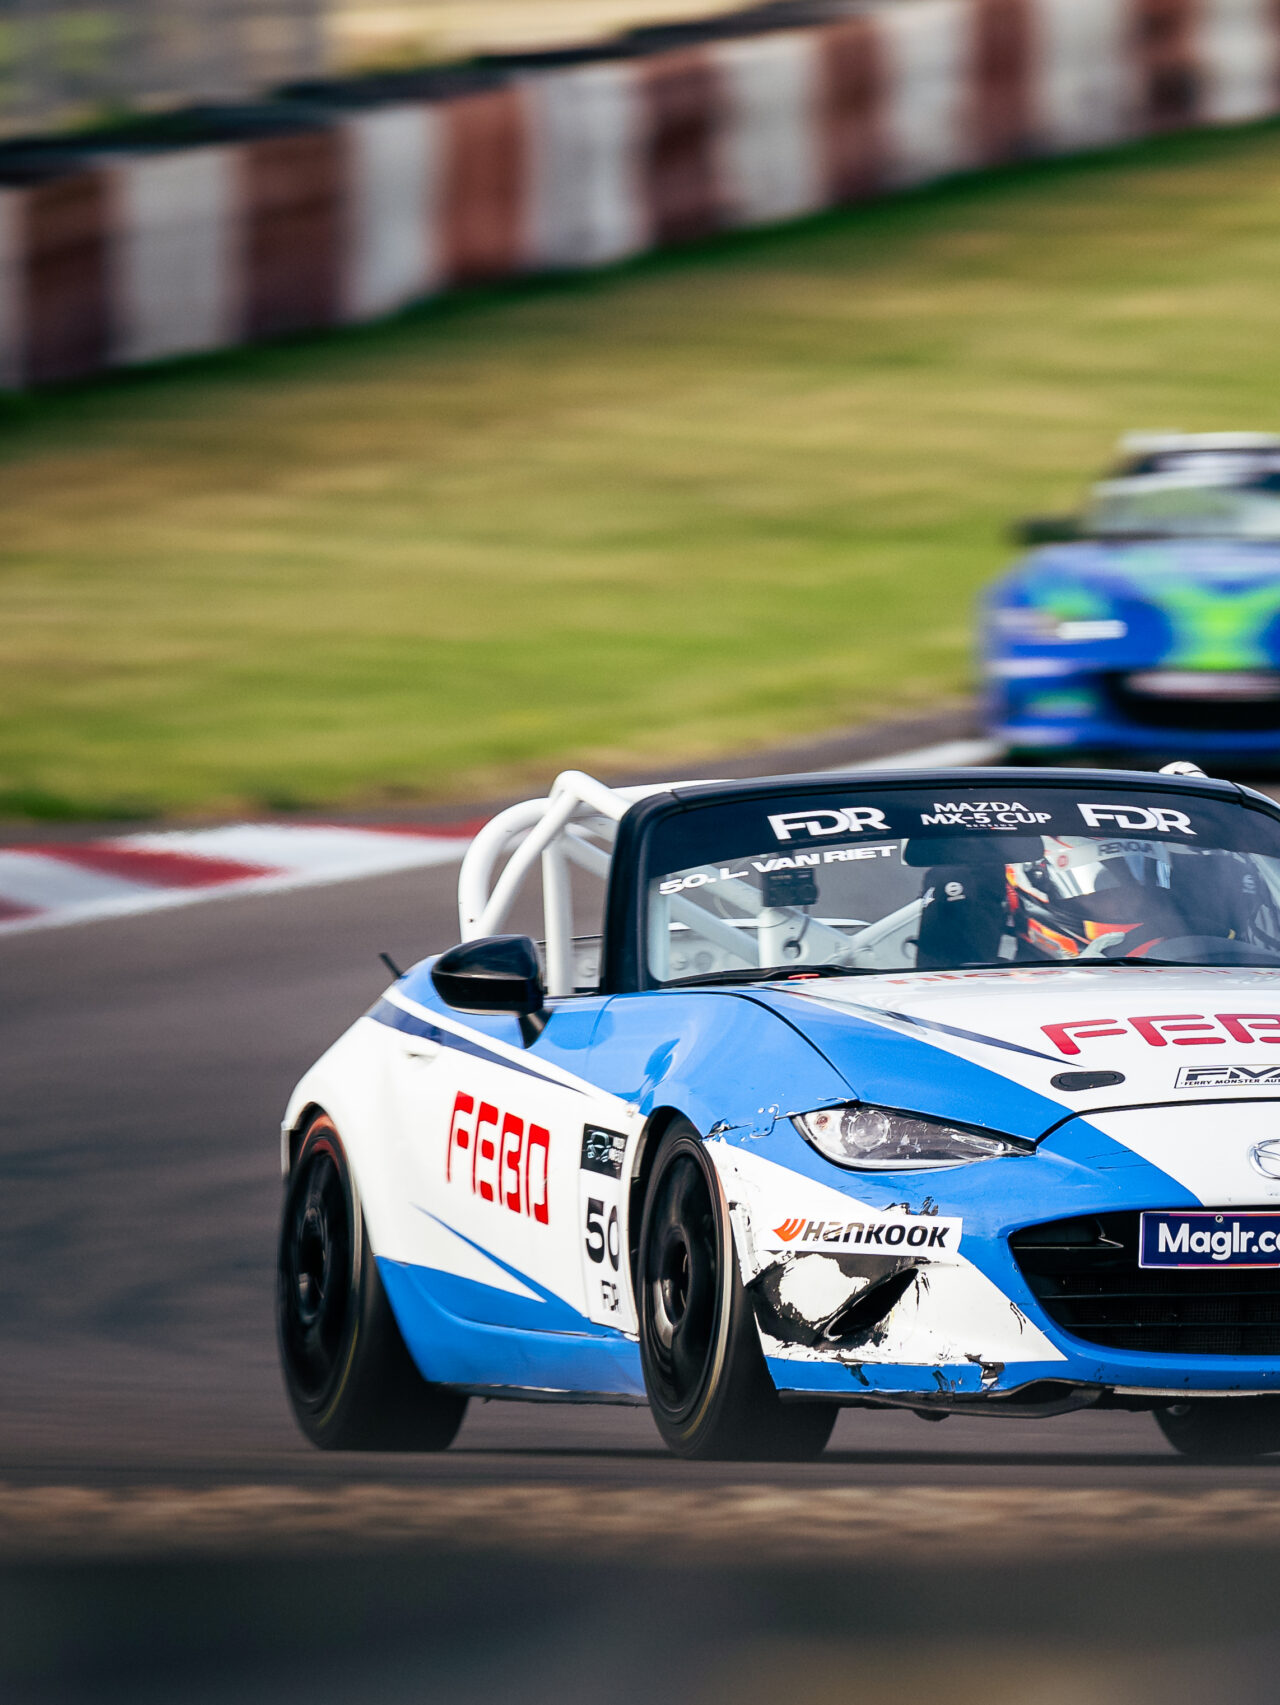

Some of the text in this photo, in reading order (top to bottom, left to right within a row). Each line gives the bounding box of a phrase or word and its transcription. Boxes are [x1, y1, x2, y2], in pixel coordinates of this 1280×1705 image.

[920, 812, 1053, 825] MX-5 CUP
[933, 802, 1030, 812] MAZDA
[1077, 803, 1198, 835] FDR
[767, 807, 891, 840] FDR
[751, 853, 820, 873] VAN
[824, 845, 898, 863] RIET
[585, 1197, 619, 1272] 50
